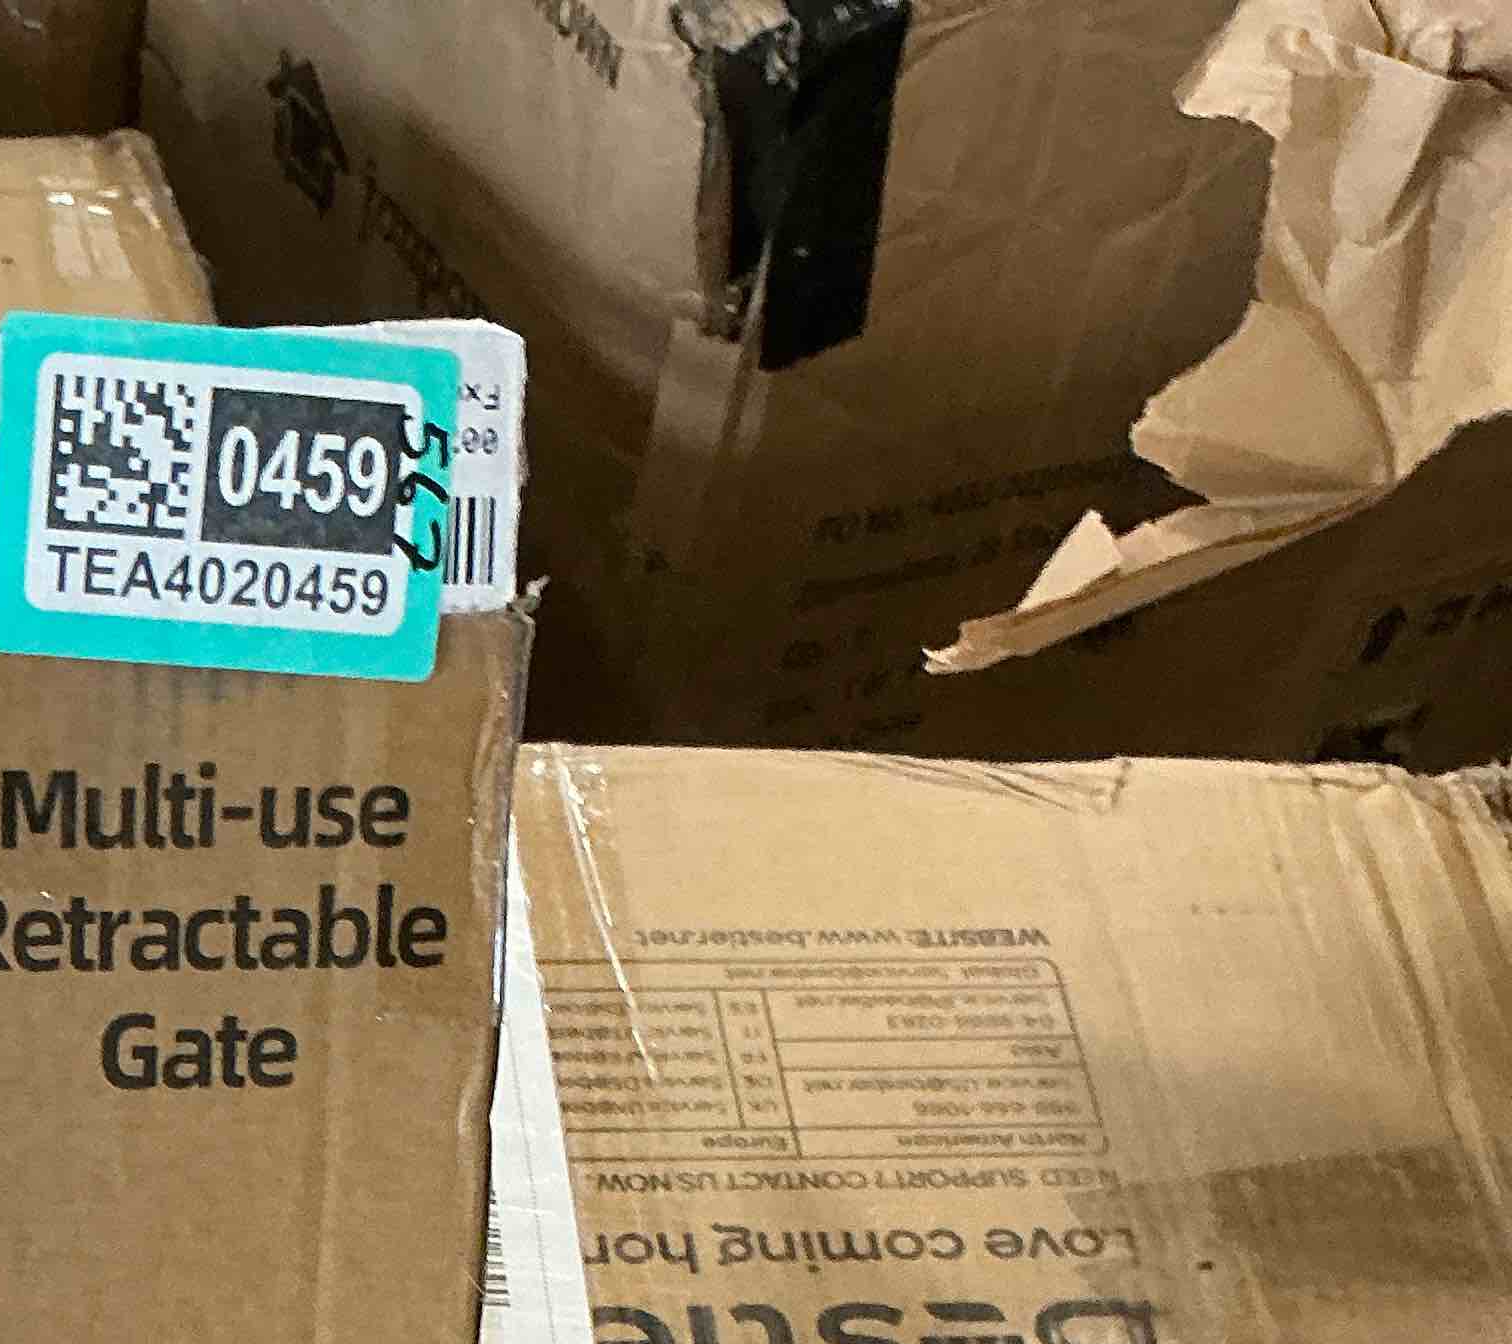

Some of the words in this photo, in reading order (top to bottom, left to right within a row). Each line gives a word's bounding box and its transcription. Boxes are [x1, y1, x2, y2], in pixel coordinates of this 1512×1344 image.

[217, 426, 388, 516] 0459
[46, 545, 389, 615] TEA4020459
[0, 761, 410, 849] Multi-use
[100, 1012, 299, 1090] Gate
[712, 1222, 966, 1276] coming
[984, 1226, 1141, 1264] Love
